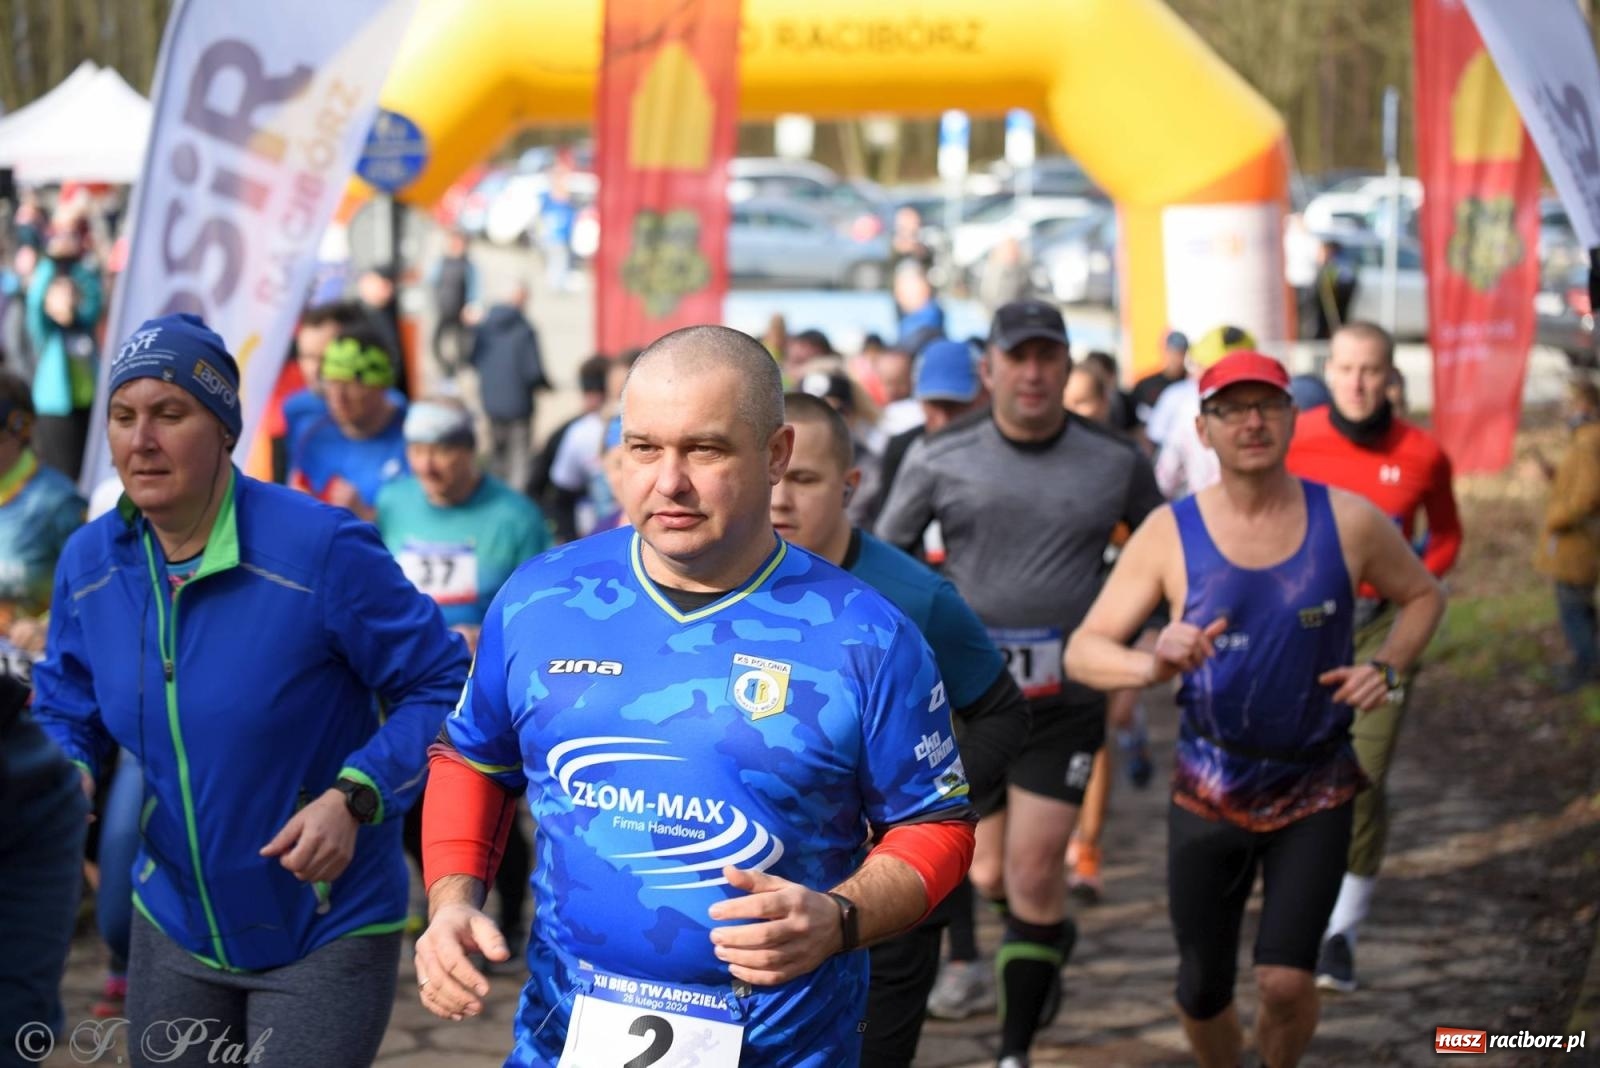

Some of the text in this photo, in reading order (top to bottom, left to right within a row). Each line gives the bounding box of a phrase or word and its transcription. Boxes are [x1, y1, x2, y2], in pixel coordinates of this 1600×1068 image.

[751, 659, 788, 673] POLONIA
[571, 780, 725, 825] ZŁOM-MAX
[612, 815, 706, 840] Firma Handlowa
[594, 974, 728, 1011] XII BIEG TWARDZIELA
[635, 996, 664, 1011] lutego
[665, 1001, 688, 1013] 2024
[623, 1014, 674, 1068] 2
